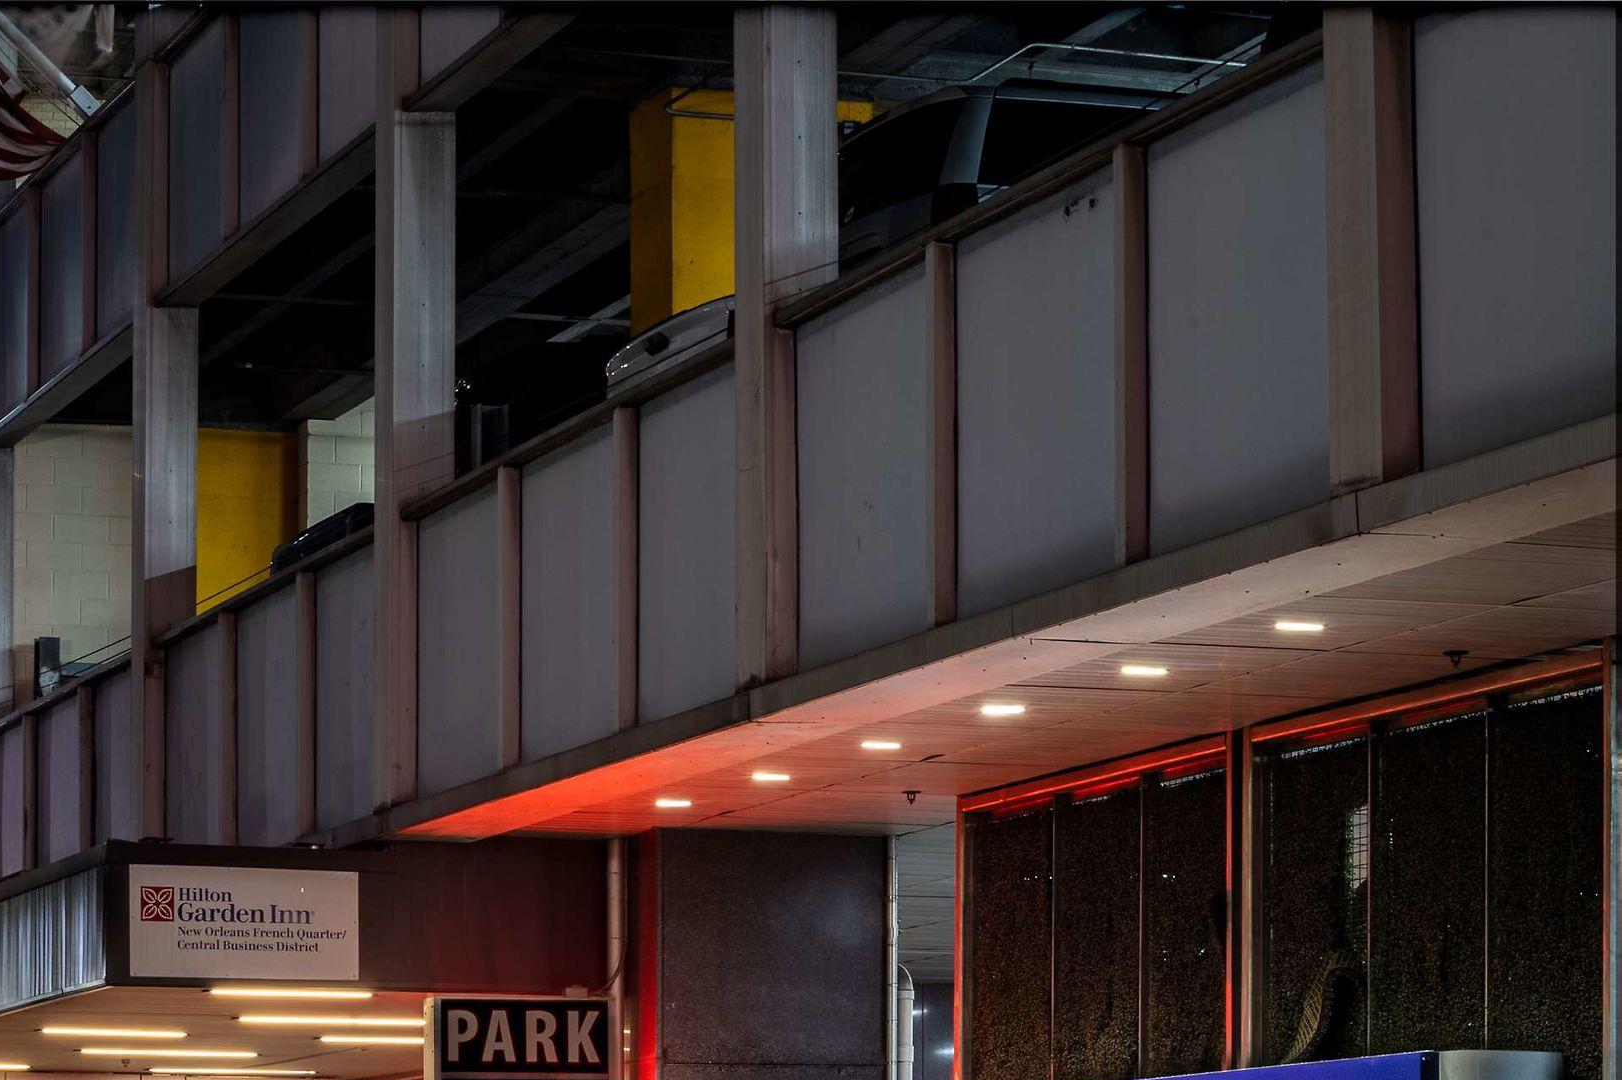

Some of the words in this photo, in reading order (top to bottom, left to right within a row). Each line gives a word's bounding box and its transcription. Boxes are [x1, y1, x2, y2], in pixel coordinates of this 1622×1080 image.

[178, 887, 232, 902] Hilton
[178, 902, 266, 924] Garden
[269, 904, 312, 924] Inn
[178, 926, 202, 937] New
[205, 927, 250, 938] Orleans
[253, 928, 294, 939] French
[296, 929, 347, 940] Quarter/
[177, 940, 220, 951] Central
[223, 941, 273, 952] Business
[277, 942, 319, 953] District
[447, 1009, 601, 1063] PARK
